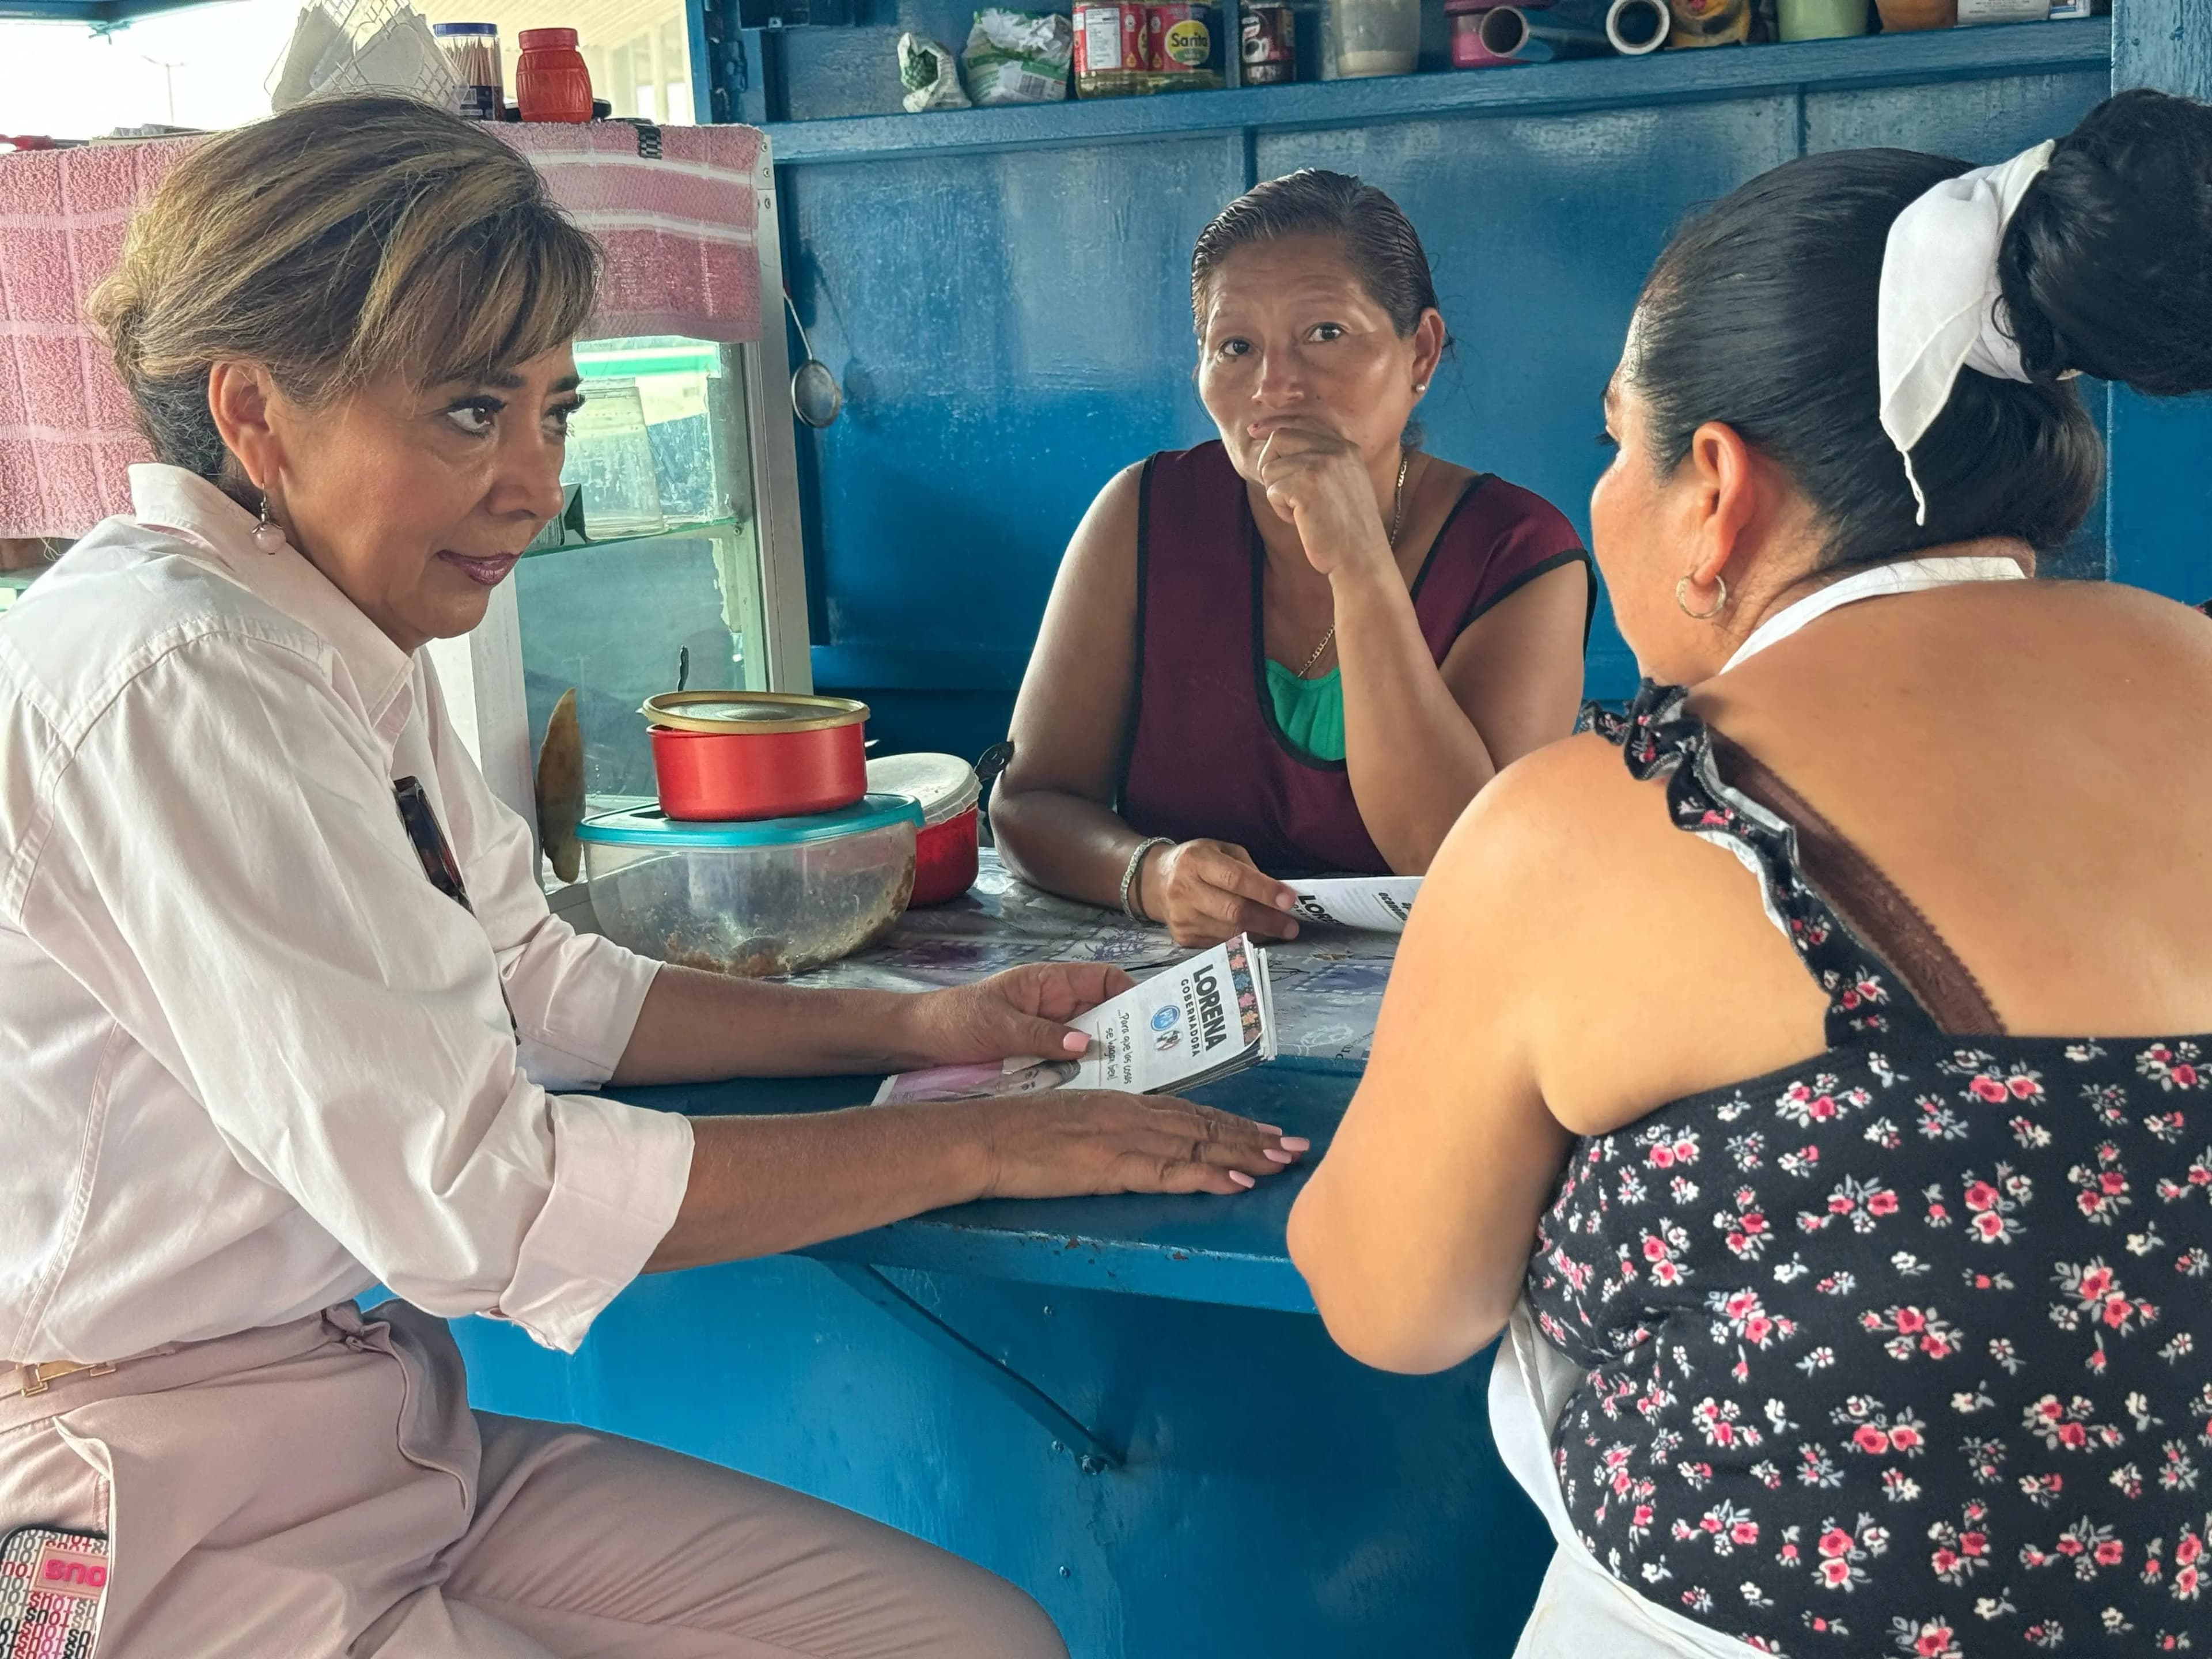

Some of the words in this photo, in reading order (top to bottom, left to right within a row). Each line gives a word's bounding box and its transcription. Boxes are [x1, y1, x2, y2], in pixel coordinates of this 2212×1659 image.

[1171, 32, 1208, 47] Sarita
[1193, 964, 1227, 1051] LORENA
[1181, 979, 1200, 1057] GOBERNADORA
[1105, 1027, 1114, 1040] se
[1120, 1036, 1131, 1052] que
[1124, 1051, 1133, 1064] las
[46, 1559, 106, 1587] OUS
